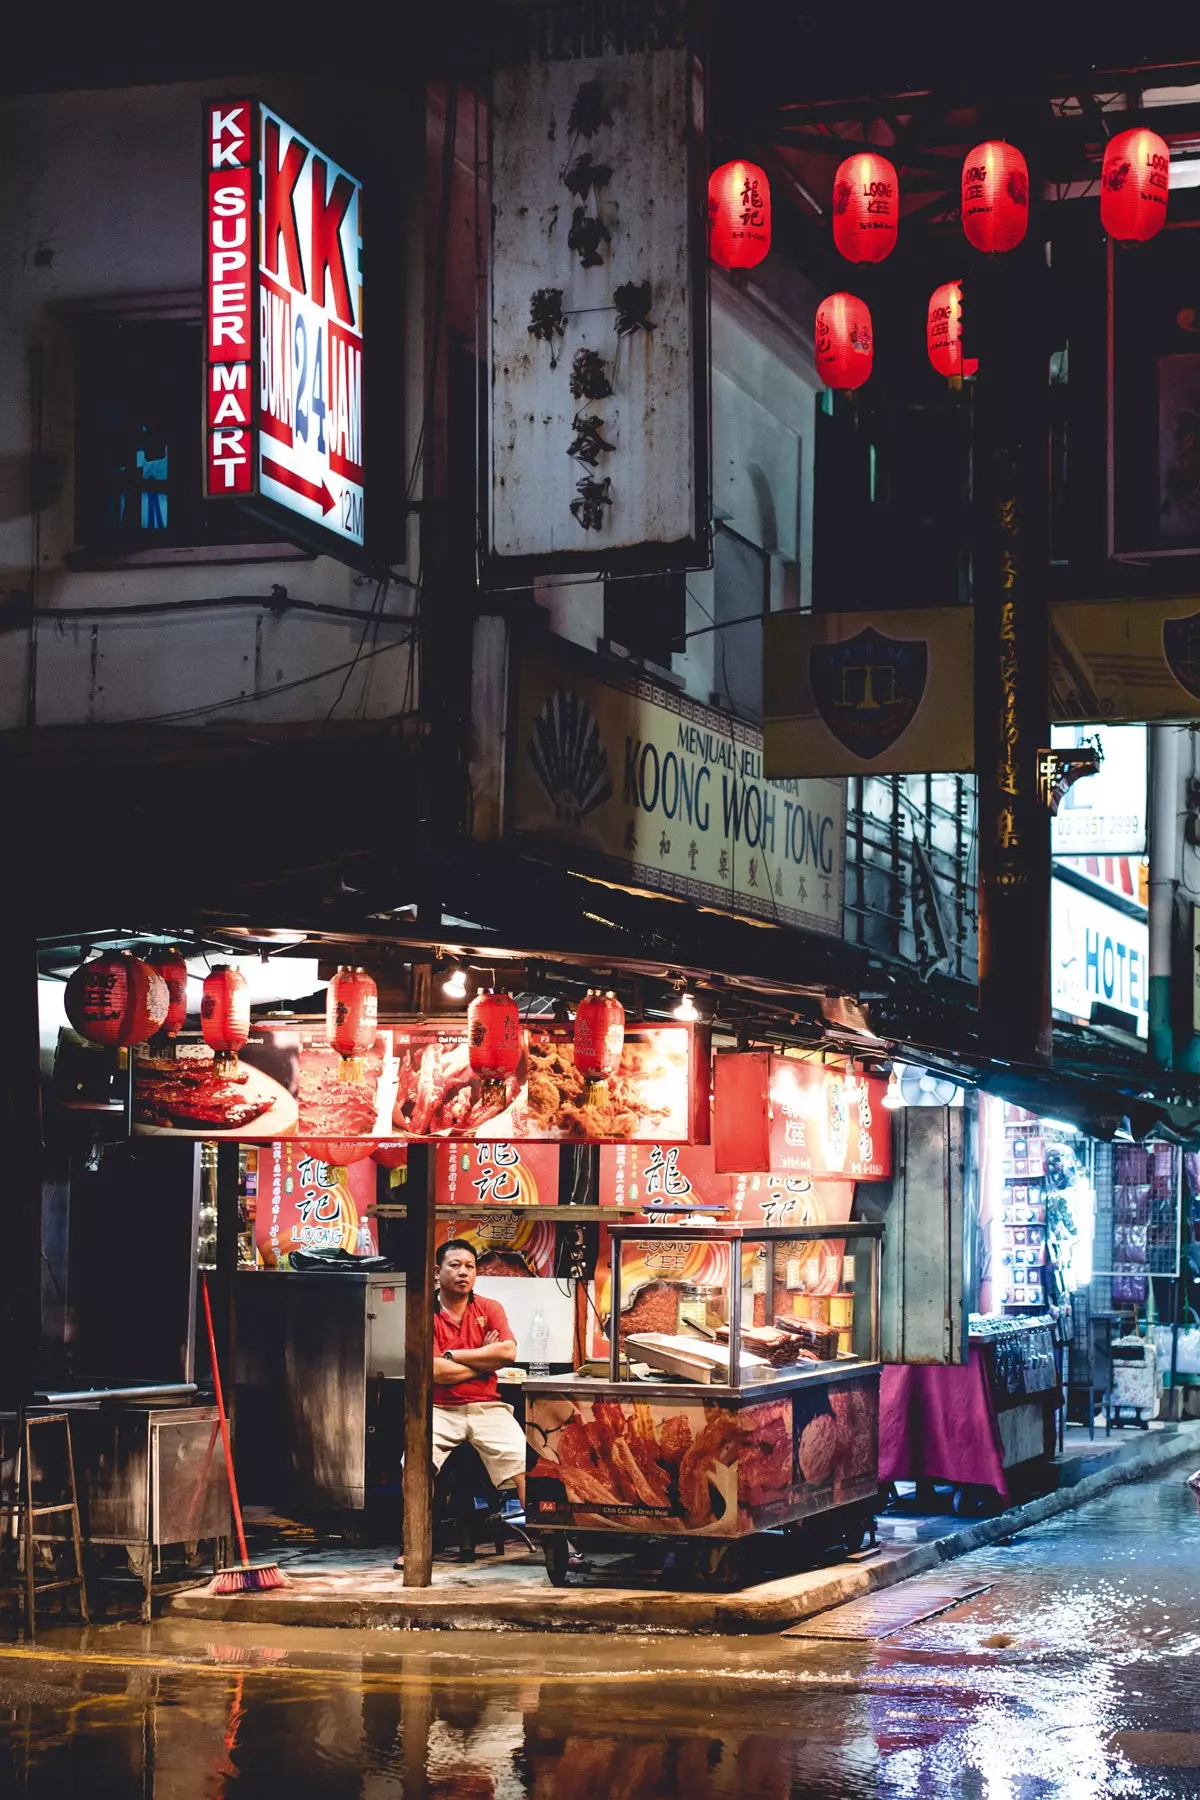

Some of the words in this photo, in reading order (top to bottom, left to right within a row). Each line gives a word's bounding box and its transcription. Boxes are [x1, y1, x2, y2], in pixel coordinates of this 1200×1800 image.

[211, 108, 245, 169] KK
[739, 178, 764, 227] 龍記
[864, 182, 892, 198] LOONG
[868, 200, 891, 214] KEE
[264, 115, 358, 329] KK
[211, 186, 246, 346] SUPER
[260, 285, 293, 426] BUKA
[294, 312, 326, 456] 24
[327, 329, 362, 467] JAM
[211, 362, 246, 488] MART
[339, 488, 363, 539] 12M
[677, 722, 735, 771] MENJUAL
[739, 747, 761, 780] JELI
[624, 735, 711, 832] KOONG
[722, 775, 776, 853] WOH
[783, 800, 834, 874] TONG
[1085, 927, 1149, 1013] HOTEL
[291, 1226, 343, 1244] LOONG
[475, 1223, 517, 1241] KEE
[643, 1252, 687, 1270] KEE
[542, 1502, 553, 1511] A4
